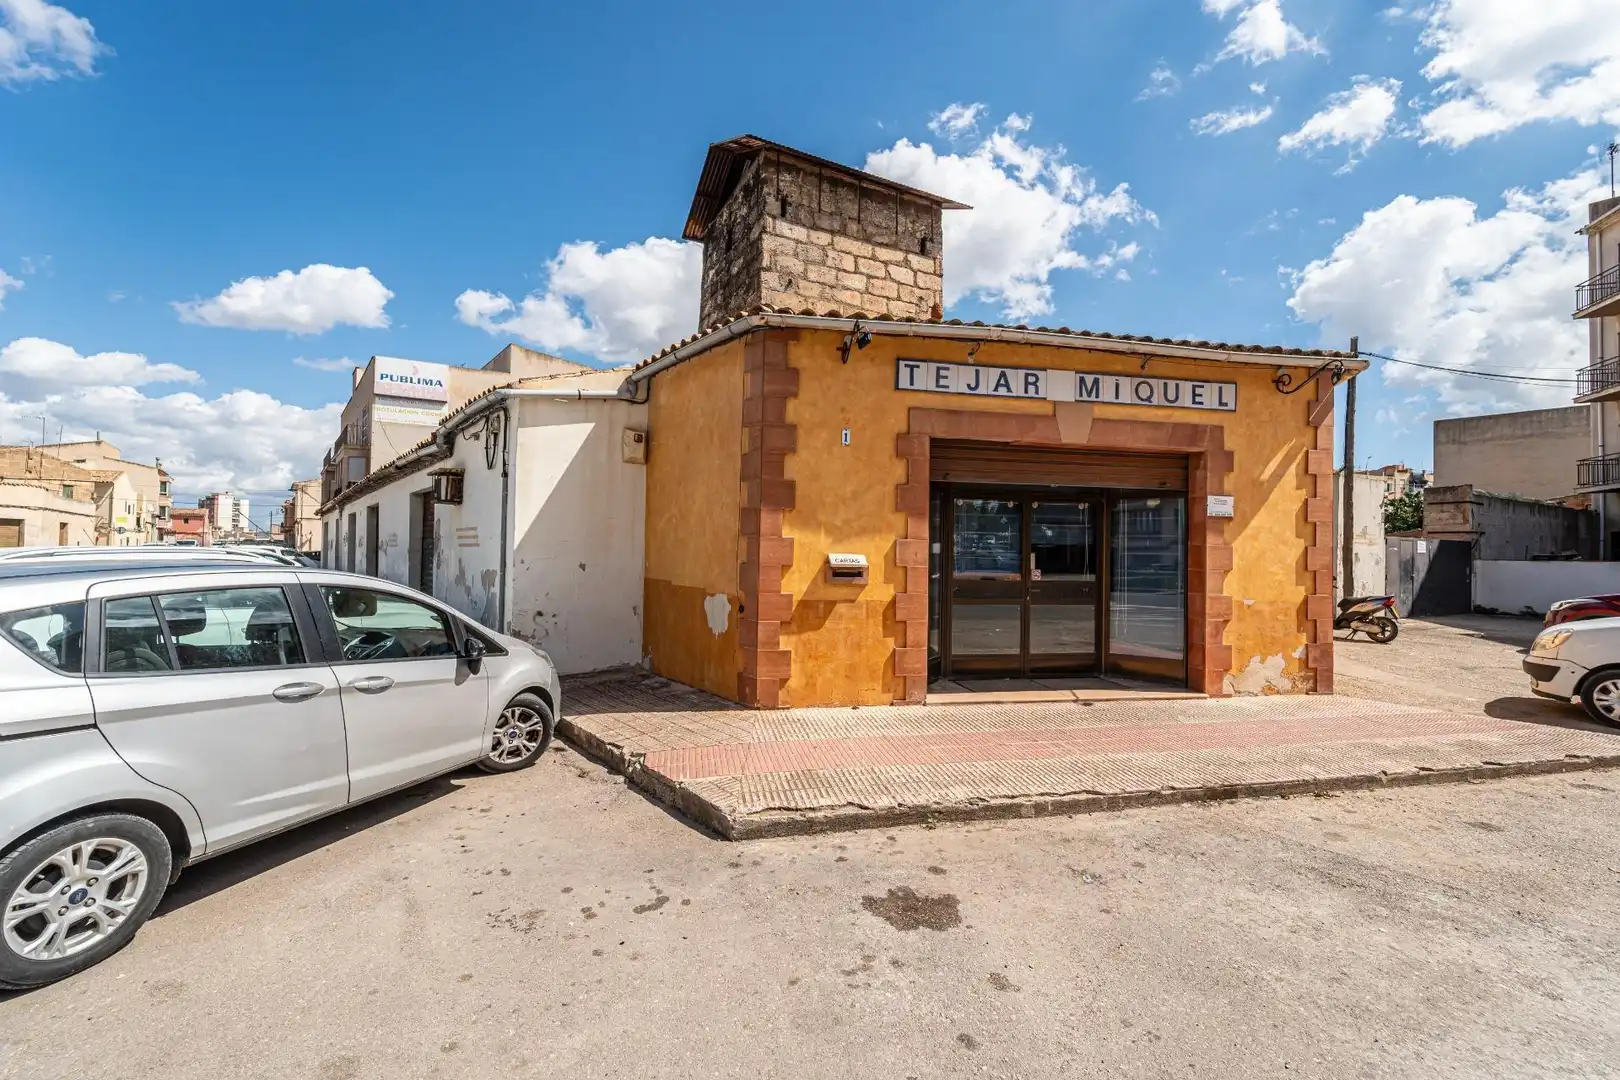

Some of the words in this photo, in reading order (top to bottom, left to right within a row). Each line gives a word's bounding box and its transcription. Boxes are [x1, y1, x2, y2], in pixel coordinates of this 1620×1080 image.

[379, 373, 443, 387] PUBLIMA
[904, 363, 1041, 395] TEJAR
[843, 432, 849, 443] 1
[834, 557, 861, 565] CARTAS
